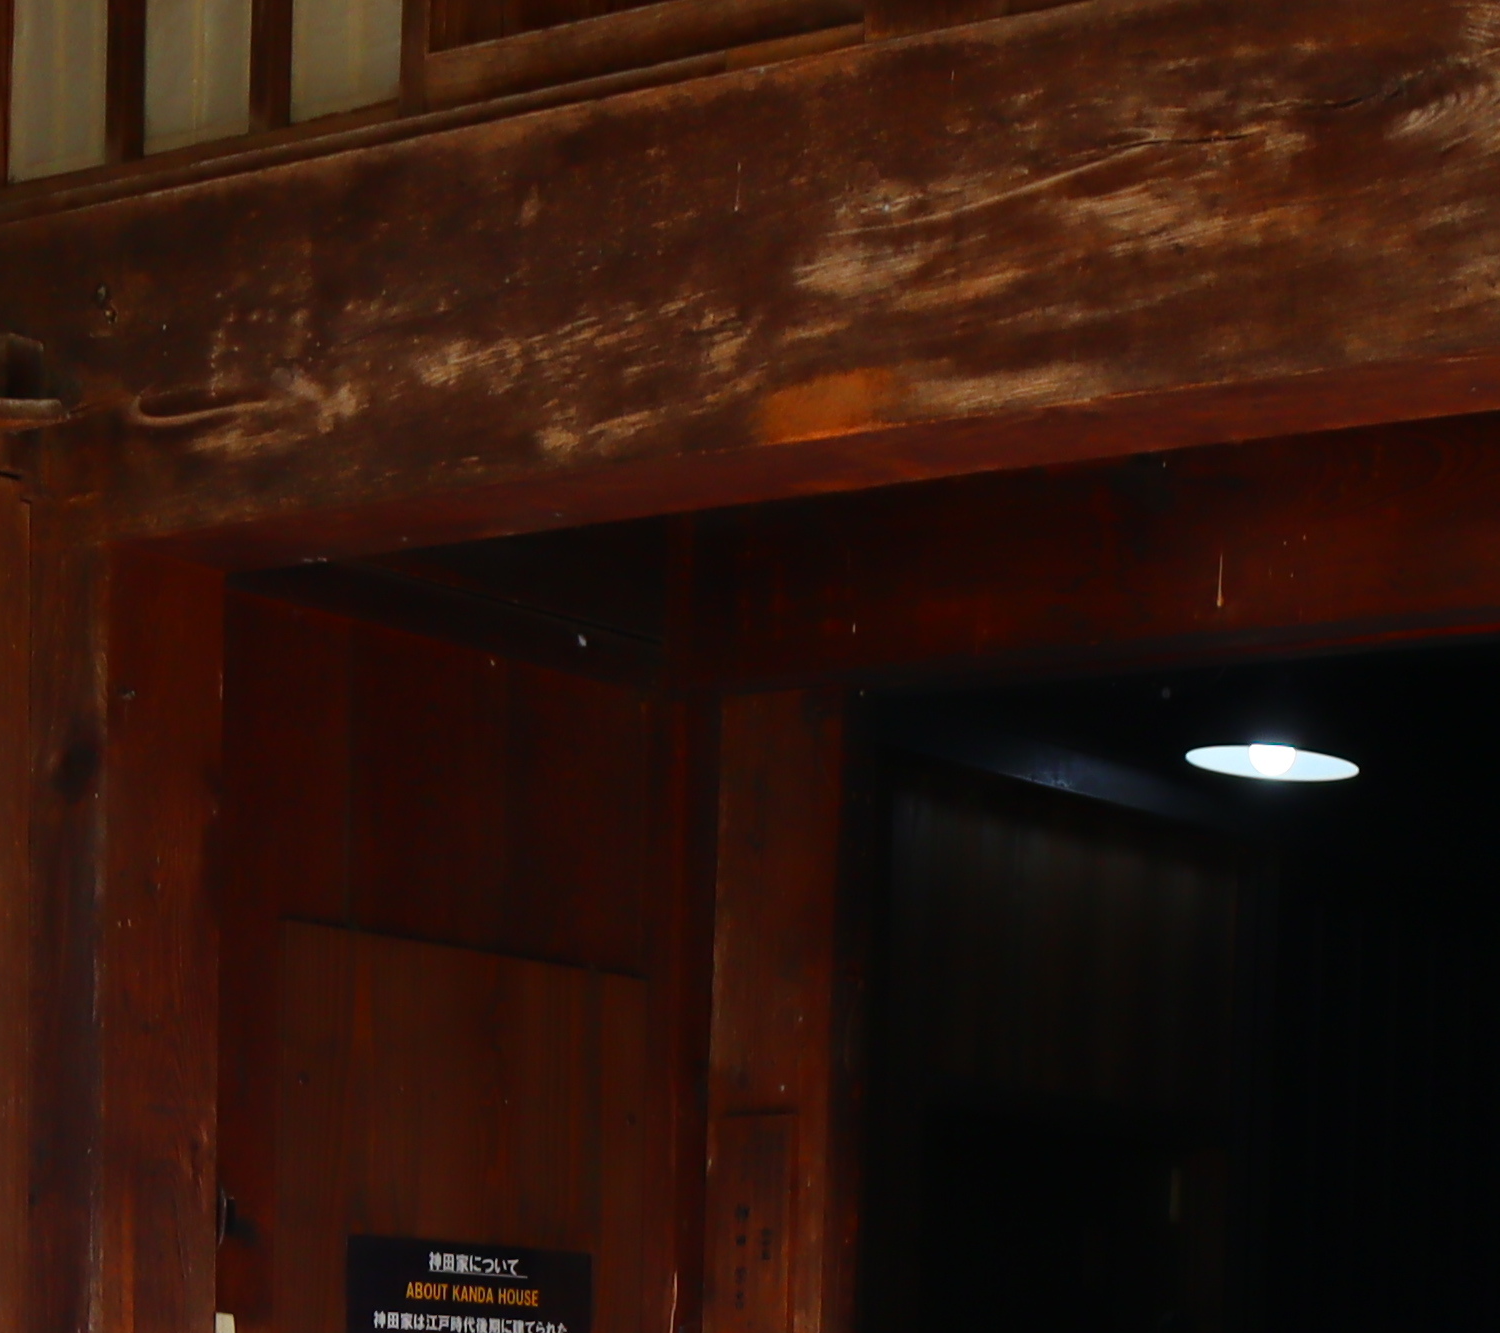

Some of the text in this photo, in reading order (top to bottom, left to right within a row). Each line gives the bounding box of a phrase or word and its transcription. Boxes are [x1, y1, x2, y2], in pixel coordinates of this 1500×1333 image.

[428, 1252, 519, 1276] 神田家について
[406, 1281, 538, 1306] ABOUT KANDA HOUSE
